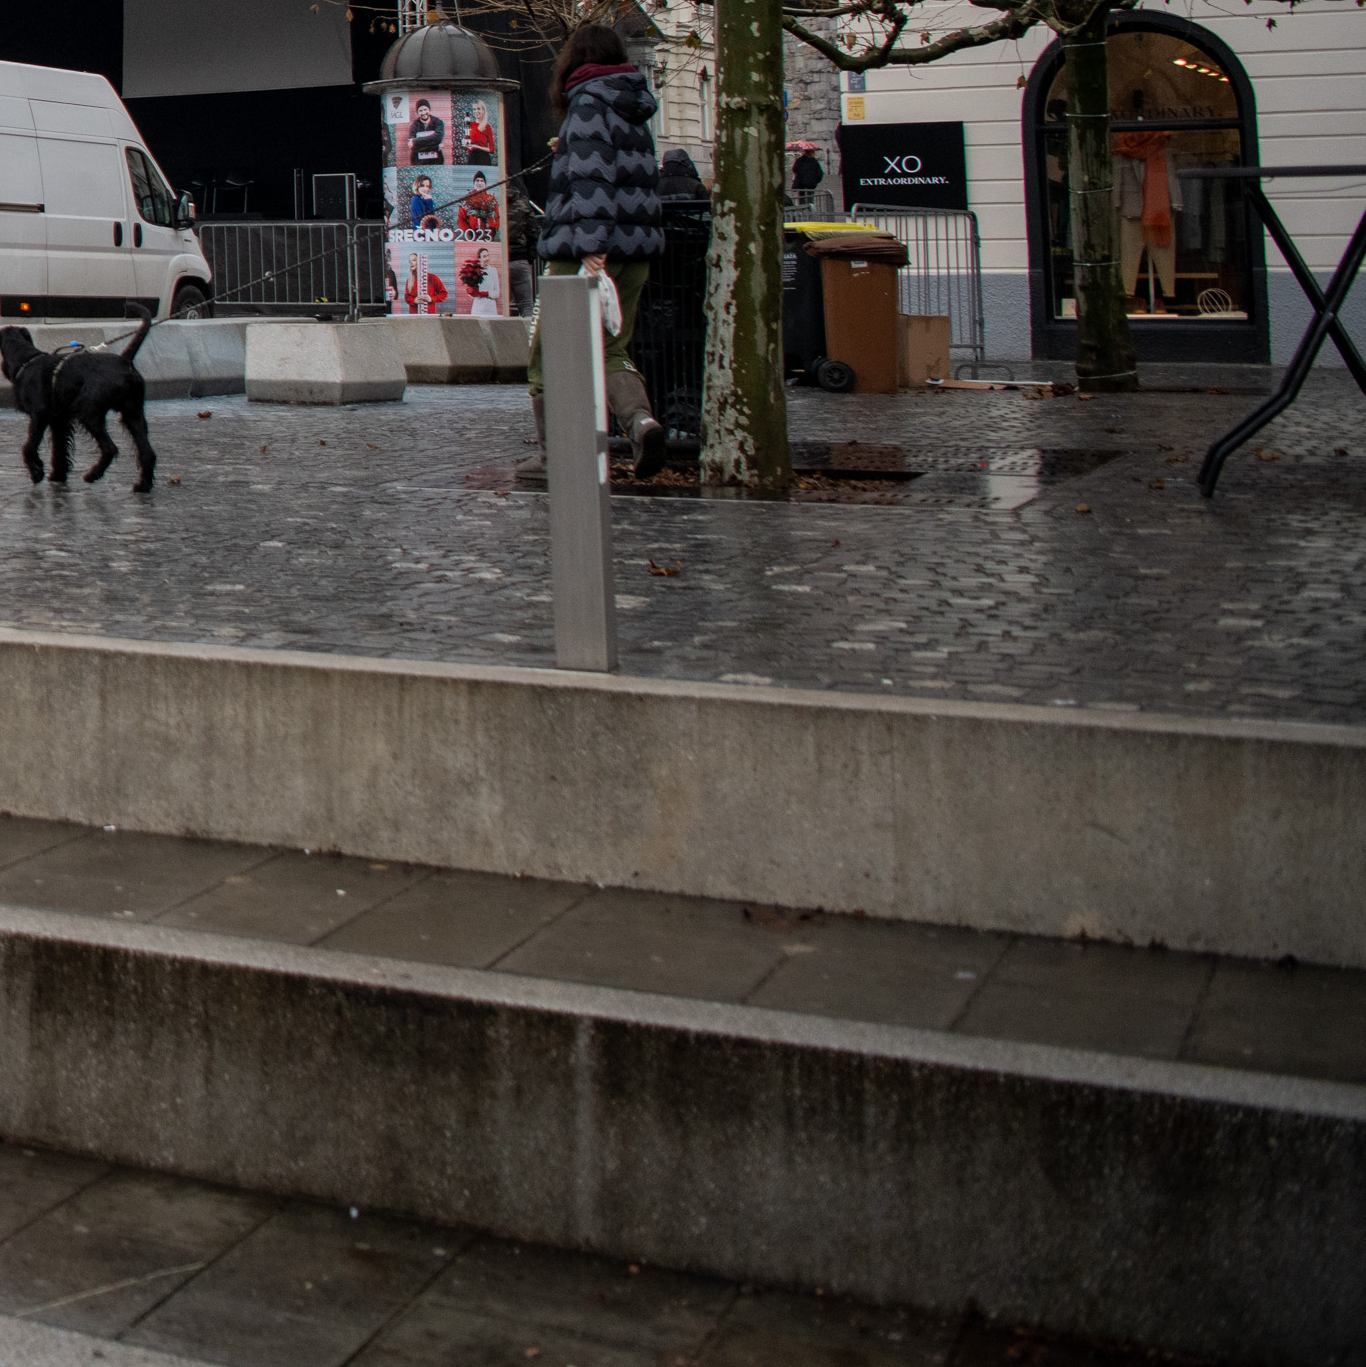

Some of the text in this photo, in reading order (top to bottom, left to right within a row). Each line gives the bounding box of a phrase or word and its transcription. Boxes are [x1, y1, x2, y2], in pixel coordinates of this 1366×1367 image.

[883, 155, 923, 174] XO
[859, 176, 949, 186] EXTRAORDINARY.
[454, 228, 493, 243] 2023
